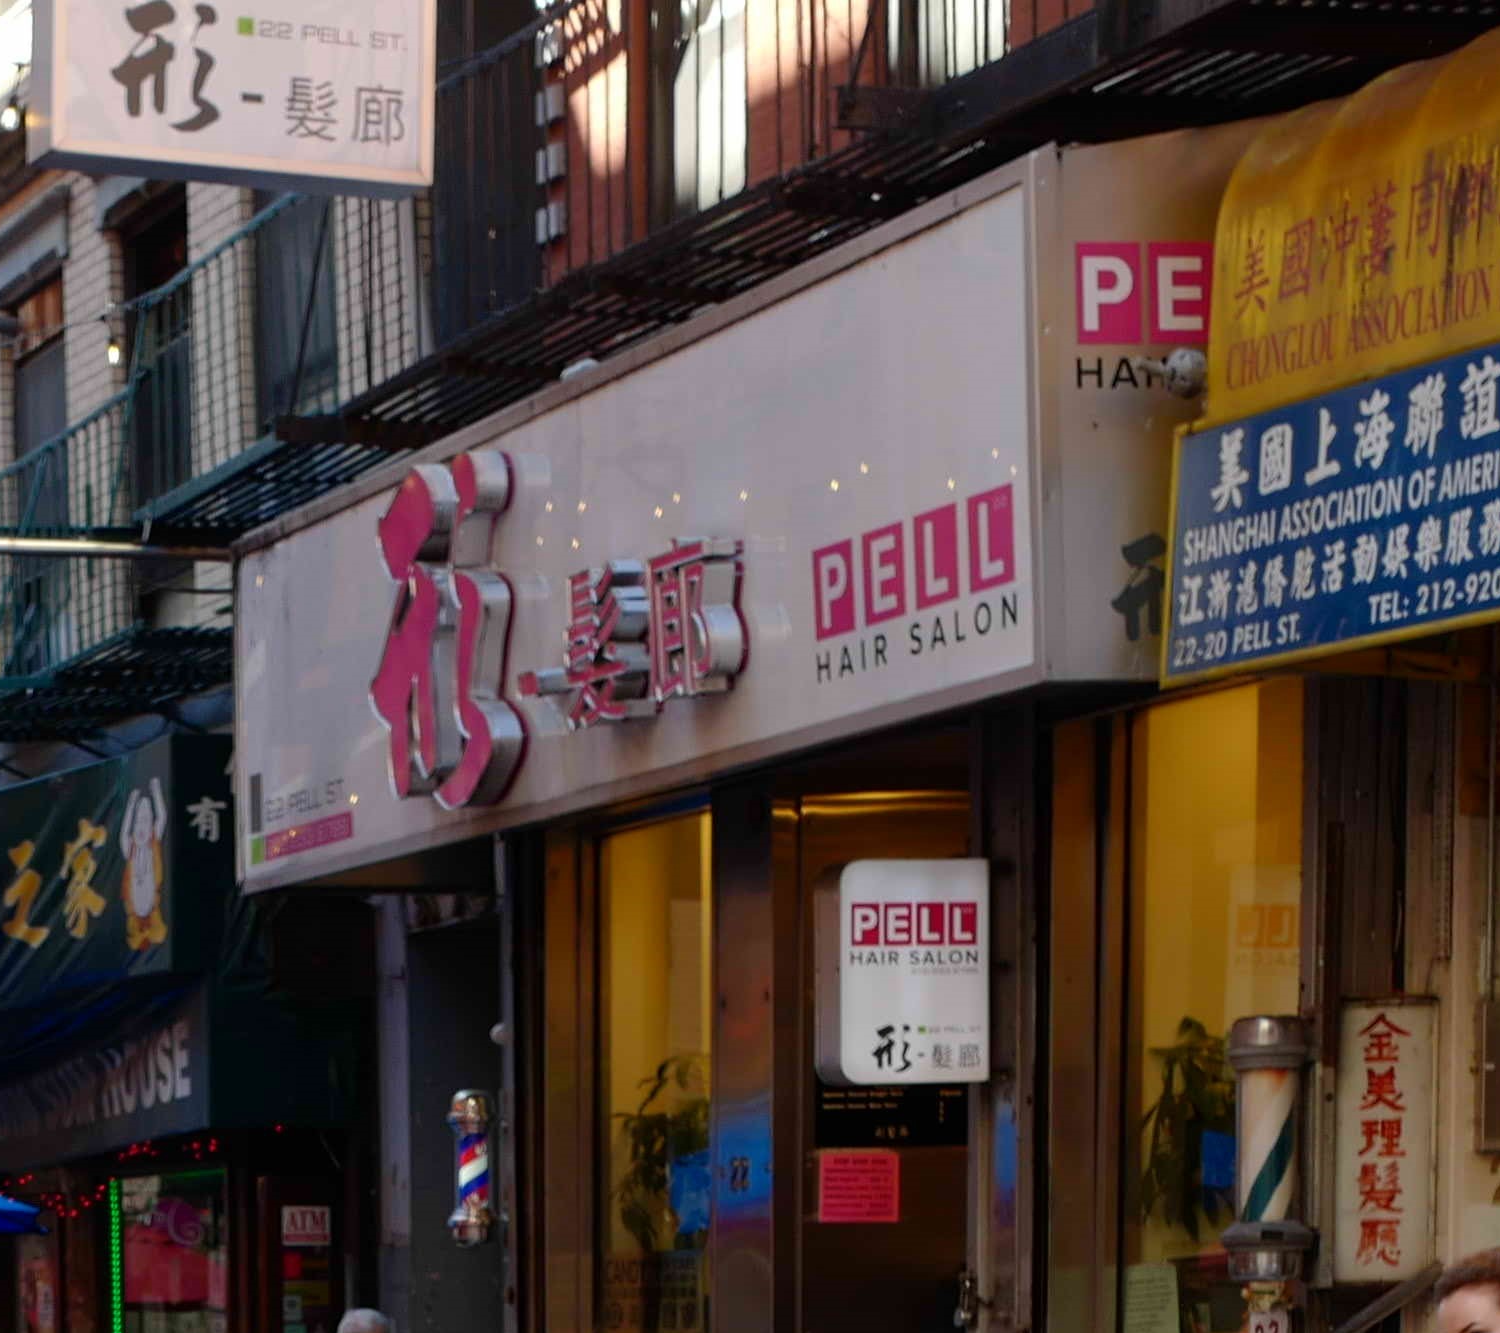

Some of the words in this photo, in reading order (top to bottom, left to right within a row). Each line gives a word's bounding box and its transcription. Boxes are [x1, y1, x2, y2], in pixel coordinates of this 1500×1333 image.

[258, 19, 293, 40] 22
[301, 23, 360, 48] PELL
[369, 31, 409, 51] ST.
[285, 76, 405, 147] 髮廊
[1348, 265, 1493, 358] ASSOCIATION
[1182, 508, 1278, 568] SHANGHAI
[1278, 476, 1402, 542] ASSOCIATION
[1408, 464, 1437, 511] OF
[816, 490, 1011, 637] PELL
[815, 633, 889, 685] HAIR
[908, 592, 1019, 656] SALON
[1174, 629, 1229, 668] 22-20
[1232, 618, 1272, 655] PELL
[1276, 612, 1302, 644] ST.
[1368, 593, 1410, 625] TEL:
[850, 950, 900, 966] HAIR
[909, 949, 980, 966] SALON
[852, 903, 977, 945] PELL
[1354, 1012, 1412, 1267] 金美理髮廳
[285, 1210, 327, 1231] ATM
